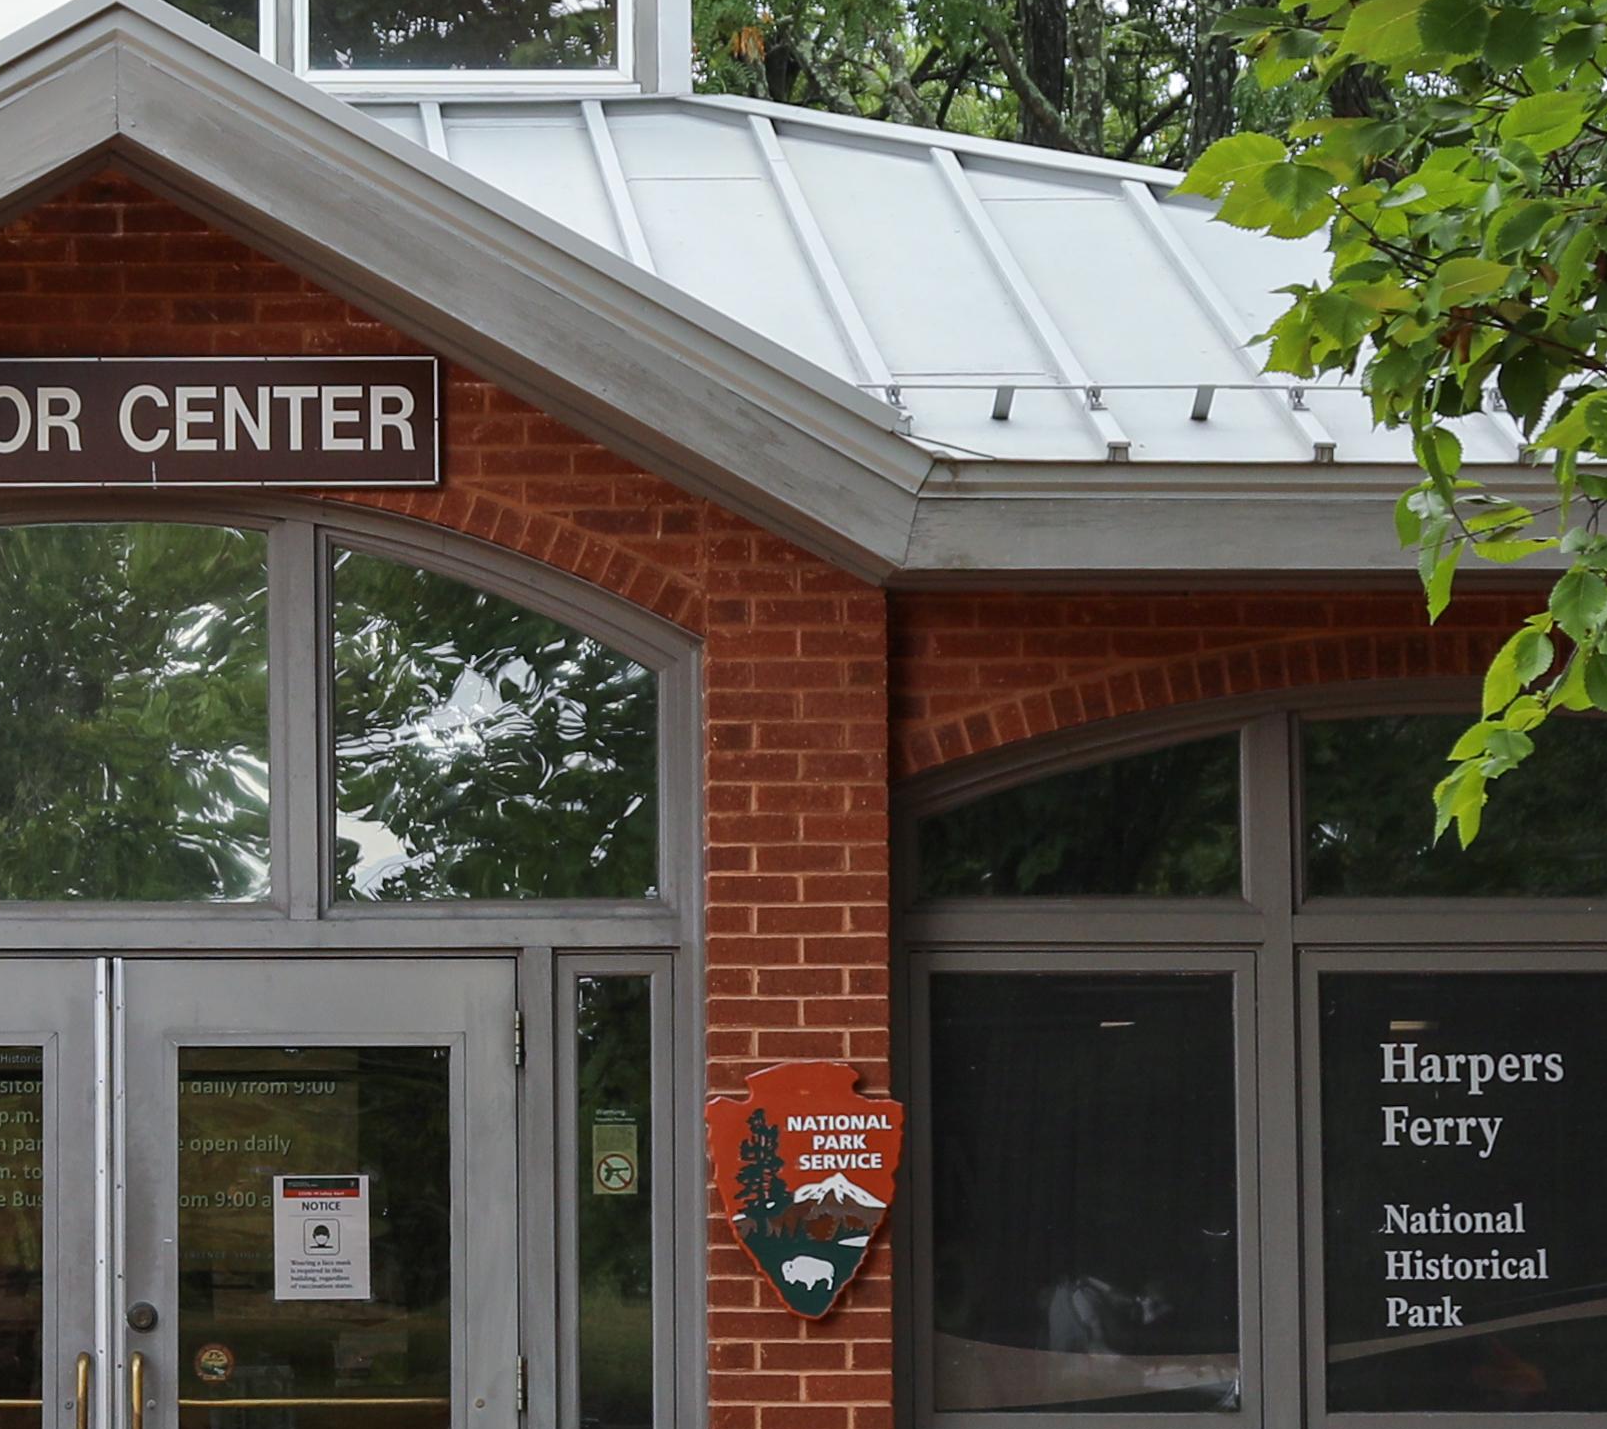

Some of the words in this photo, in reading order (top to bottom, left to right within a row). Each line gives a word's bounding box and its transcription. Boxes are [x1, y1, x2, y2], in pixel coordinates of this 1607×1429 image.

[118, 383, 416, 454] CENTER
[1380, 1042, 1564, 1095] Harpers
[787, 1115, 892, 1131] NATIONAL
[1382, 1106, 1503, 1158] Ferry
[190, 1138, 238, 1155] open
[244, 1134, 291, 1155] daily
[813, 1134, 867, 1150] PARK
[23, 1164, 42, 1179] to
[799, 1153, 883, 1170] SERVICE
[215, 1191, 256, 1207] 9:00
[302, 1201, 341, 1211] NOTICE
[1384, 1202, 1525, 1234] National
[1385, 1248, 1549, 1280] Historical
[1386, 1296, 1463, 1327] Park
